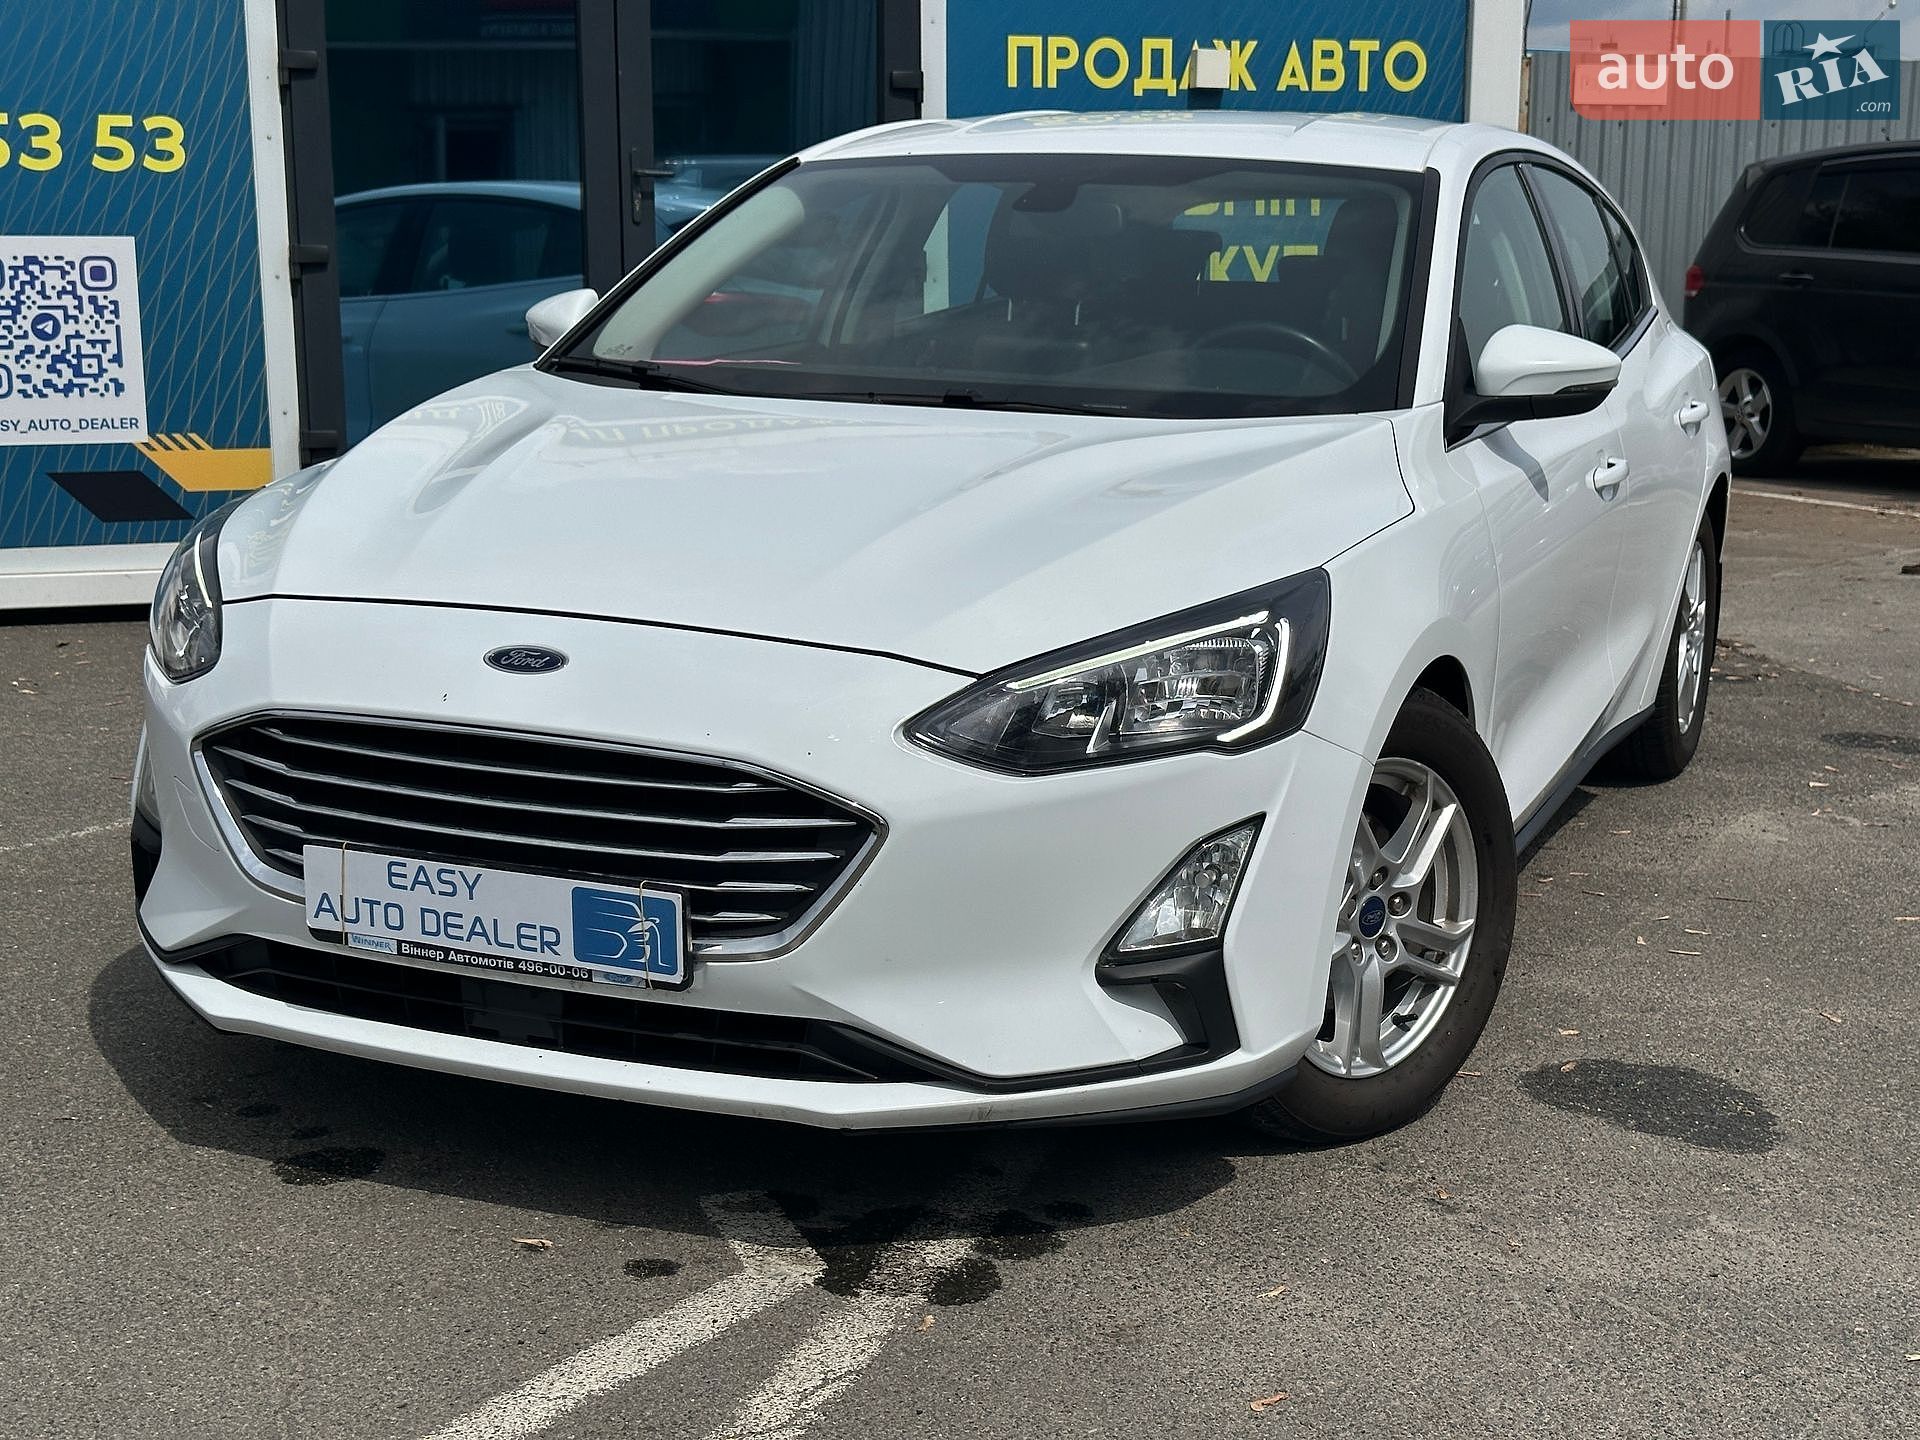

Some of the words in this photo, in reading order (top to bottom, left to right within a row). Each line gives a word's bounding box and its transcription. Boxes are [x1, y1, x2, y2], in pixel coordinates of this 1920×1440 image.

[1276, 39, 1428, 92] АВТО
[92, 114, 186, 173] 53
[387, 860, 482, 900] EASY
[313, 892, 404, 931] AUTO
[420, 907, 561, 956] DEALER
[351, 933, 394, 952] WINNER
[401, 943, 444, 961] Віннер
[448, 951, 515, 970] Автомотів
[518, 960, 589, 979] 496-00-06
